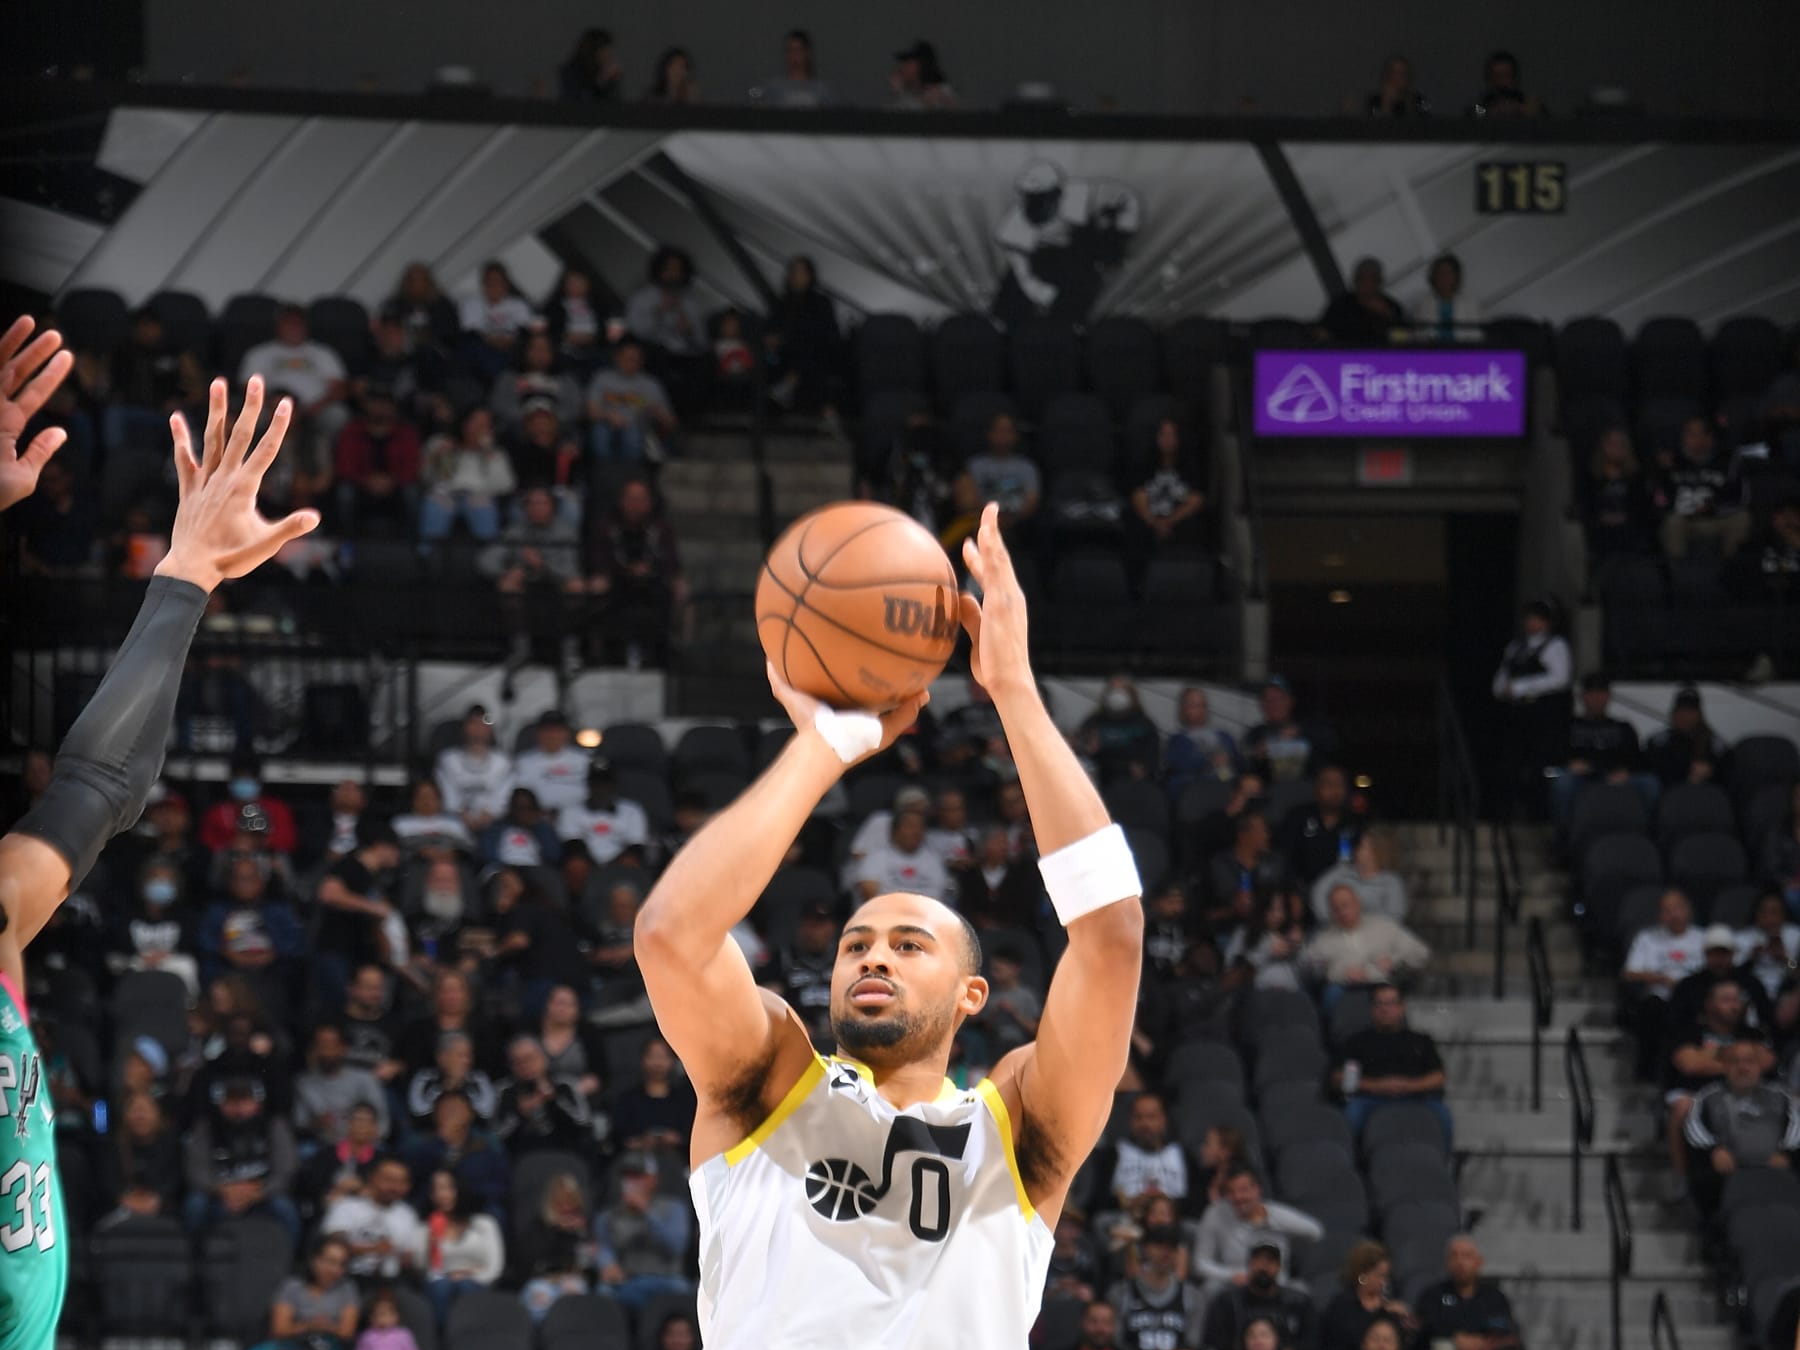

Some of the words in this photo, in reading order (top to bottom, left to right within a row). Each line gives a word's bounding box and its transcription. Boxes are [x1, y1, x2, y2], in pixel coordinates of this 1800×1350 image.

[1481, 166, 1562, 209] 115
[1340, 361, 1512, 402] Firstmark
[0, 1160, 56, 1253] 33
[909, 1157, 951, 1242] 0
